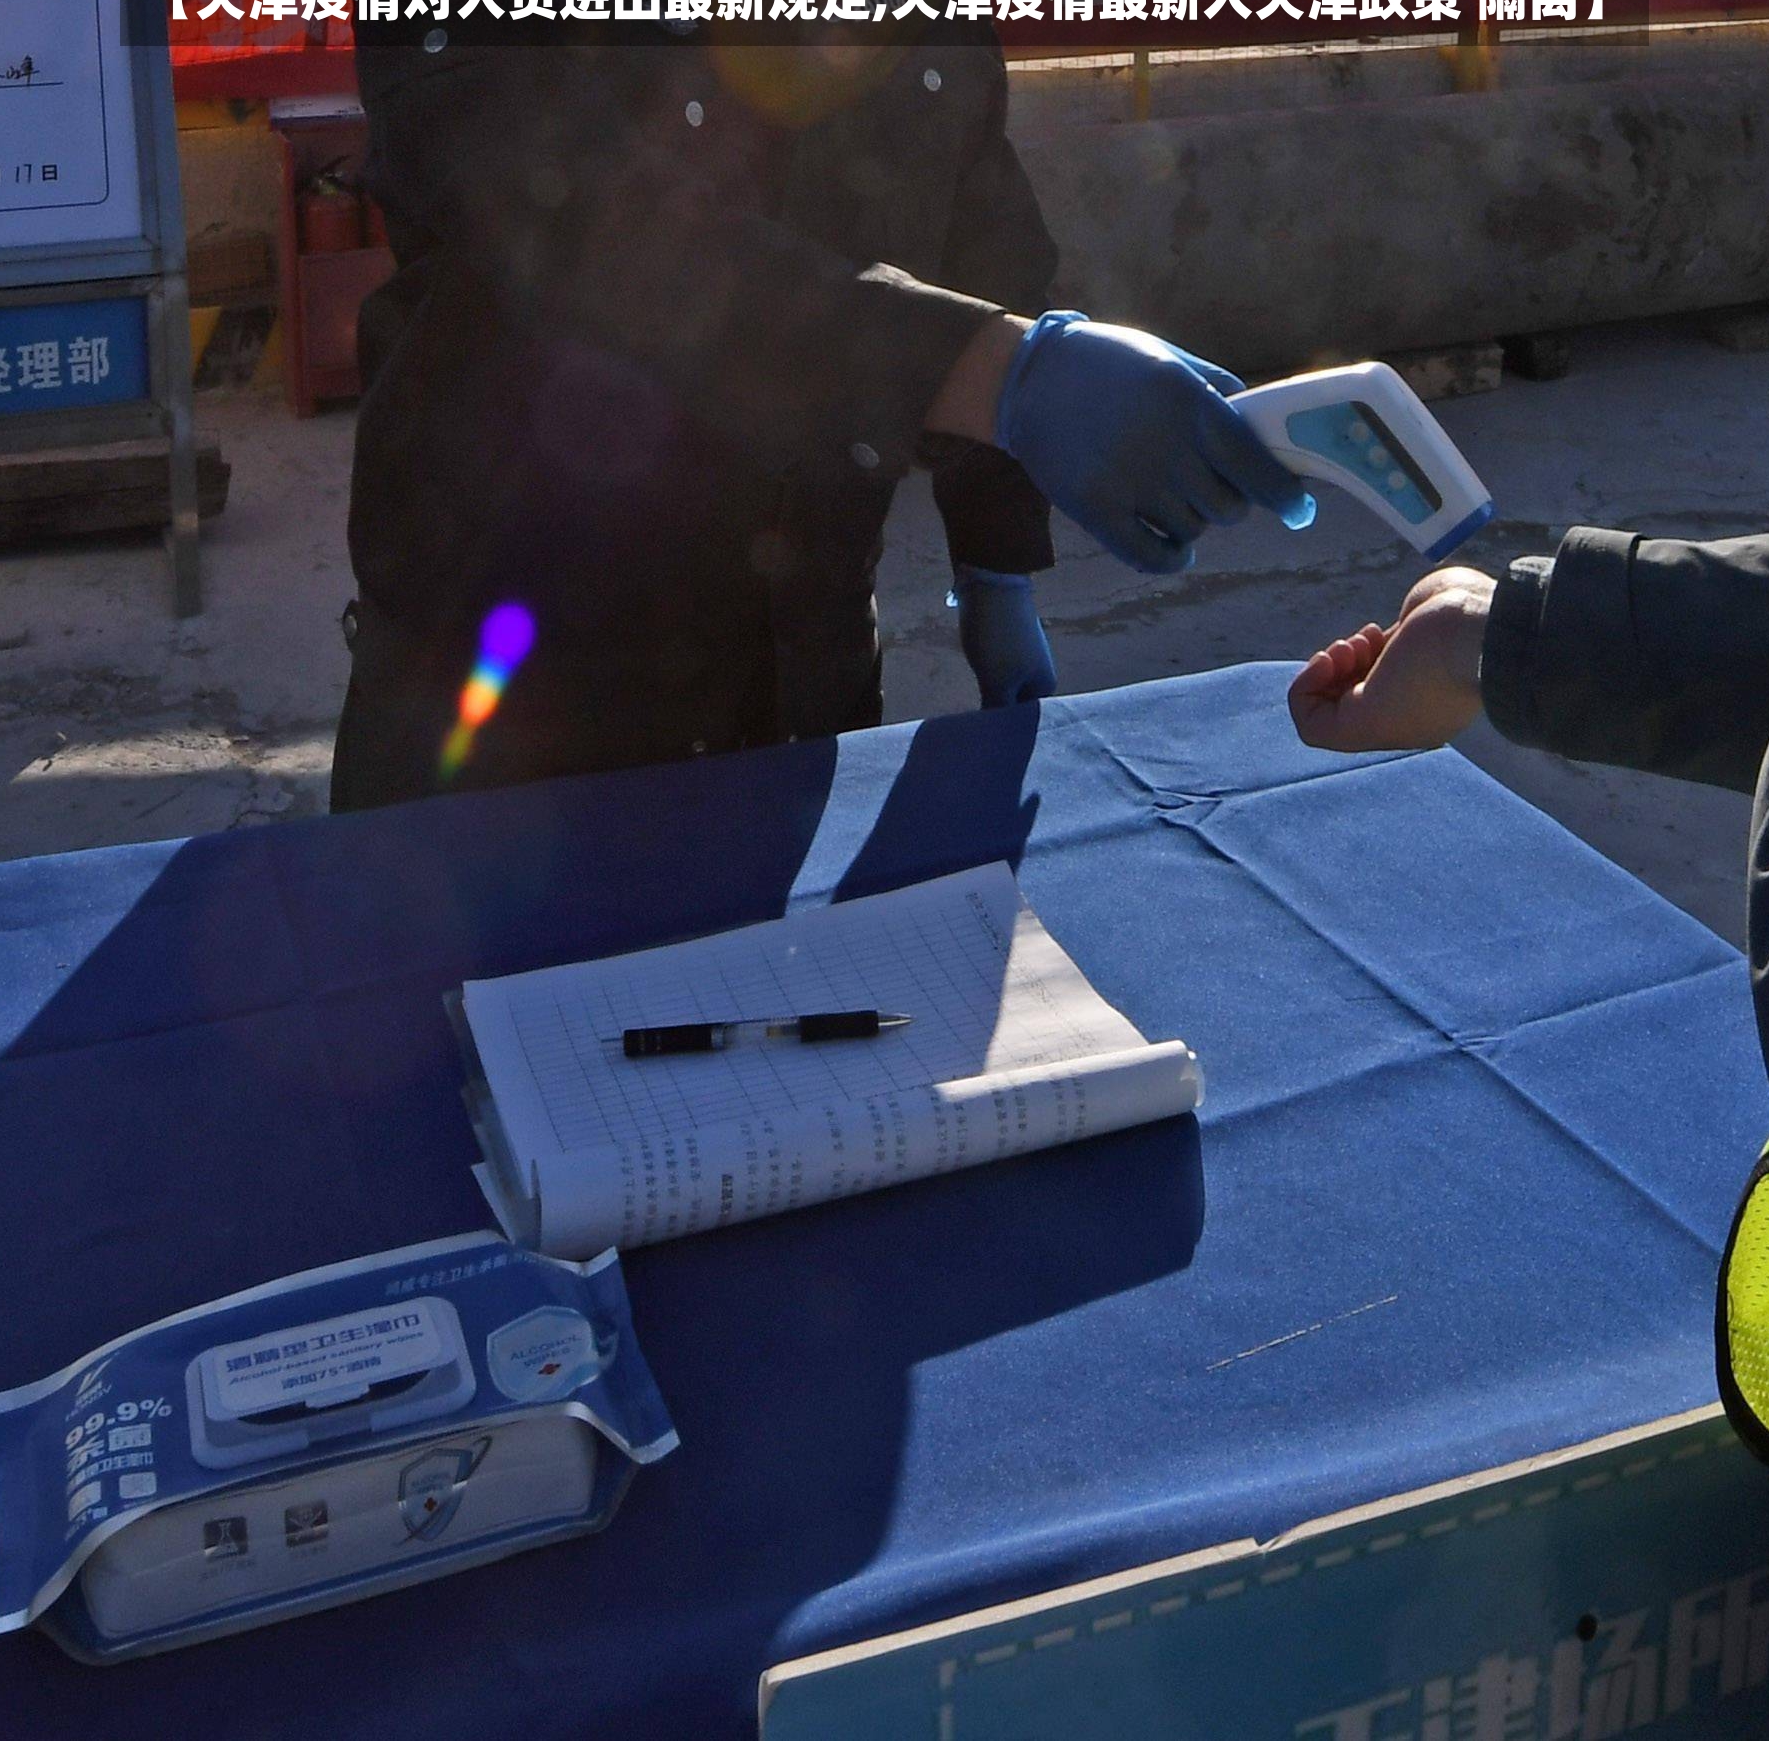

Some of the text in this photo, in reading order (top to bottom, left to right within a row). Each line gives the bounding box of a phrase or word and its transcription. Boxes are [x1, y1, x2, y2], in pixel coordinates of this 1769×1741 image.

[224, 1311, 422, 1374] 酒精型卫生湿巾
[65, 1398, 173, 1450] 99.9%
